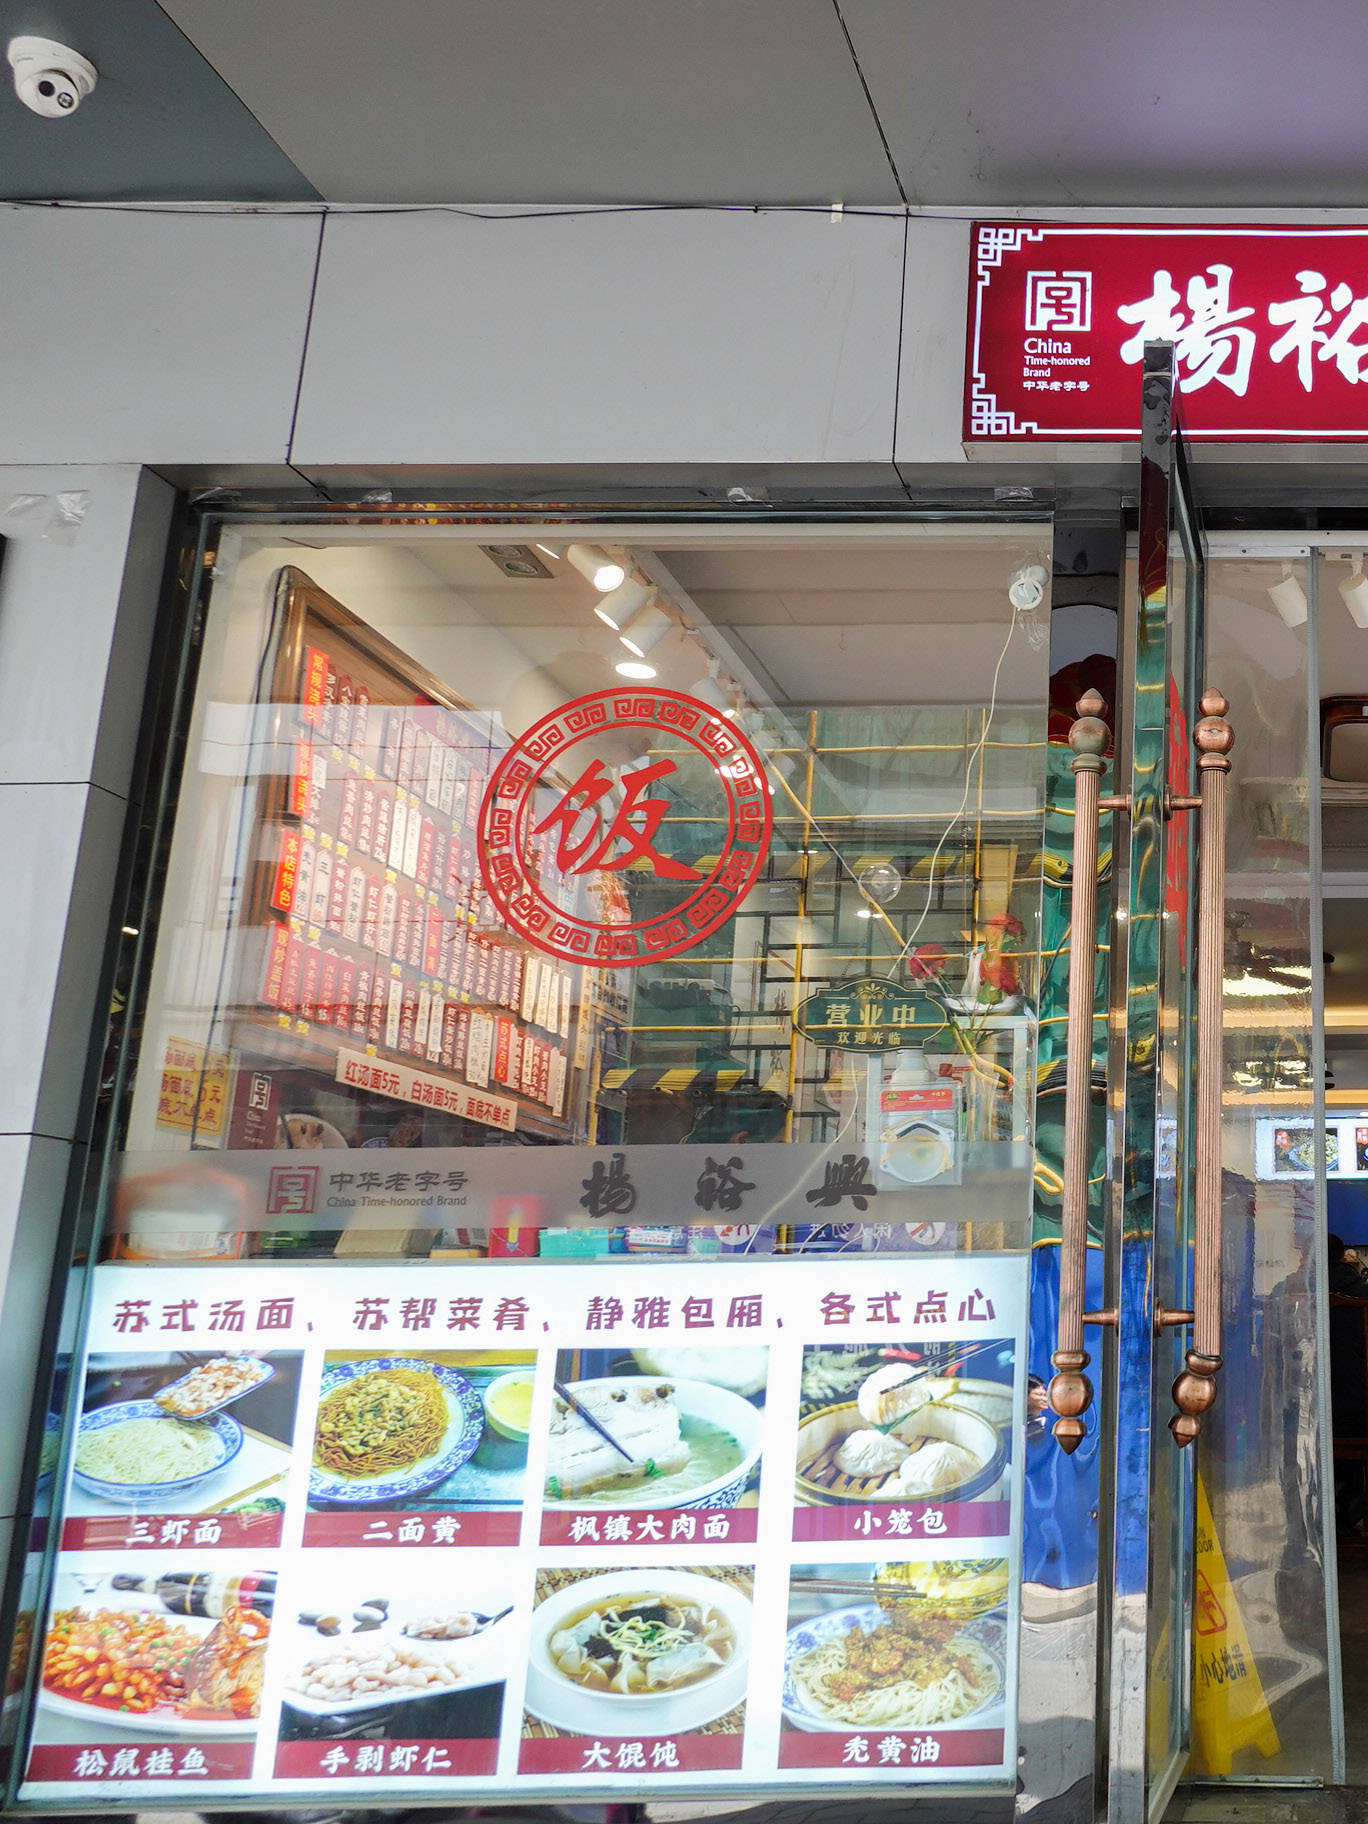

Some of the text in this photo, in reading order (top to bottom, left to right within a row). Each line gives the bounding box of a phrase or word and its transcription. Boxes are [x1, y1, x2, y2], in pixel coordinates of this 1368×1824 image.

[1023, 337, 1072, 354] China
[1022, 367, 1051, 377] Brand
[1023, 355, 1091, 366] Time-honored
[1022, 380, 1090, 391] 中华老字号
[533, 758, 704, 880] 饭
[279, 837, 299, 908] 本店特色
[825, 1003, 916, 1028] 营业中
[837, 1031, 902, 1046] 欢迎光临
[328, 1170, 469, 1193] 中华老字号
[579, 1153, 878, 1219] 楊裕興
[327, 1194, 467, 1207] China Time-honored Brand
[125, 1518, 222, 1546] 三虾面
[361, 1516, 462, 1544] 二面黄
[568, 1511, 731, 1543] 枫镇大肉面
[853, 1507, 949, 1537] 小笼包
[74, 1745, 210, 1777] 松鼠桂鱼
[321, 1742, 453, 1774] 手剥虾仁
[582, 1738, 681, 1769] 大馄饨
[842, 1735, 940, 1763] 秃黄油
